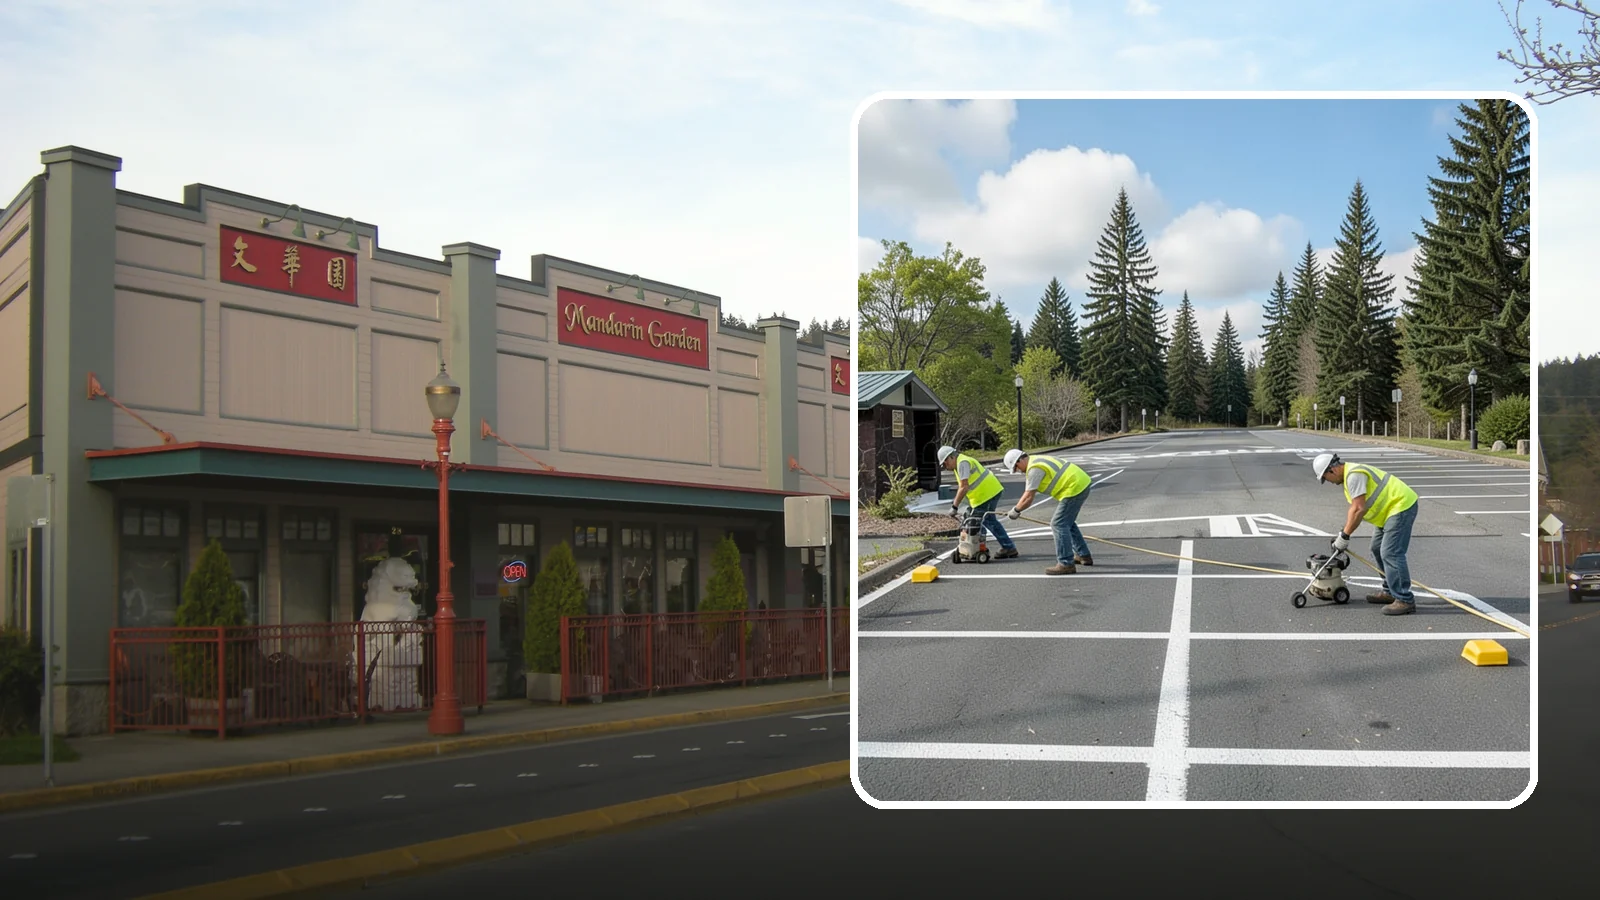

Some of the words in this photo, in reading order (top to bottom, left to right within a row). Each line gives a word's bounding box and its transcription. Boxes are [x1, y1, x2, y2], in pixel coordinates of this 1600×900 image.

[231, 236, 346, 291] 文華園
[564, 302, 644, 341] Mandarin
[648, 320, 702, 352] Garden
[503, 565, 527, 578] OPEN
